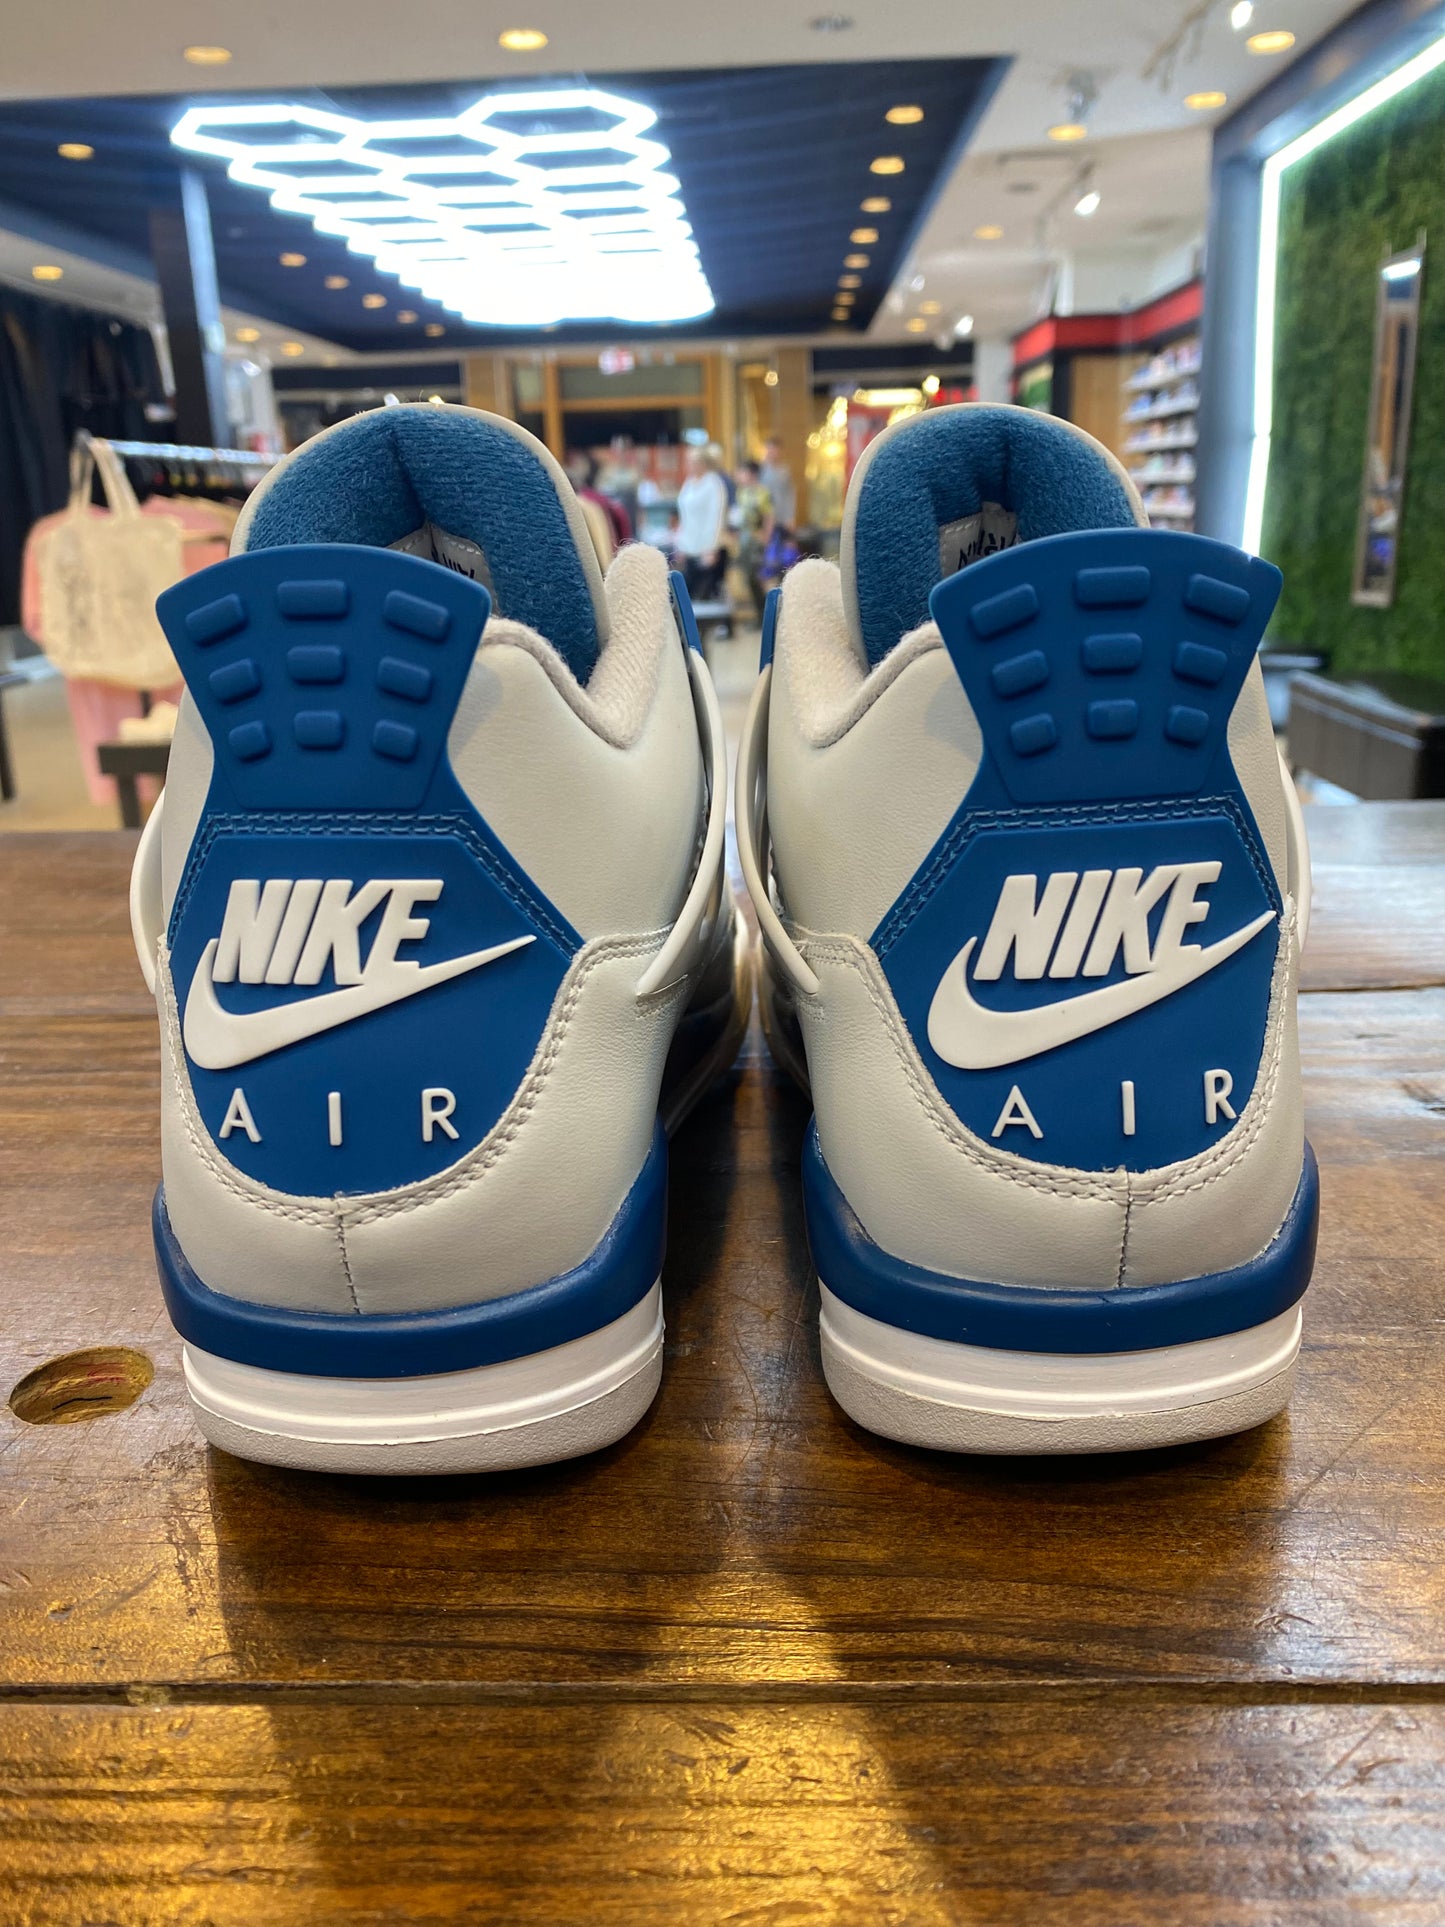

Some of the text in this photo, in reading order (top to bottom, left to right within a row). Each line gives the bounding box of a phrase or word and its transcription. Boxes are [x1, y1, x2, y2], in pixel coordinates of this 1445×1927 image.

[211, 878, 445, 986] NIKE
[972, 860, 1223, 981] NIKE
[218, 1086, 460, 1147] AIR
[990, 1068, 1238, 1140] AIR
